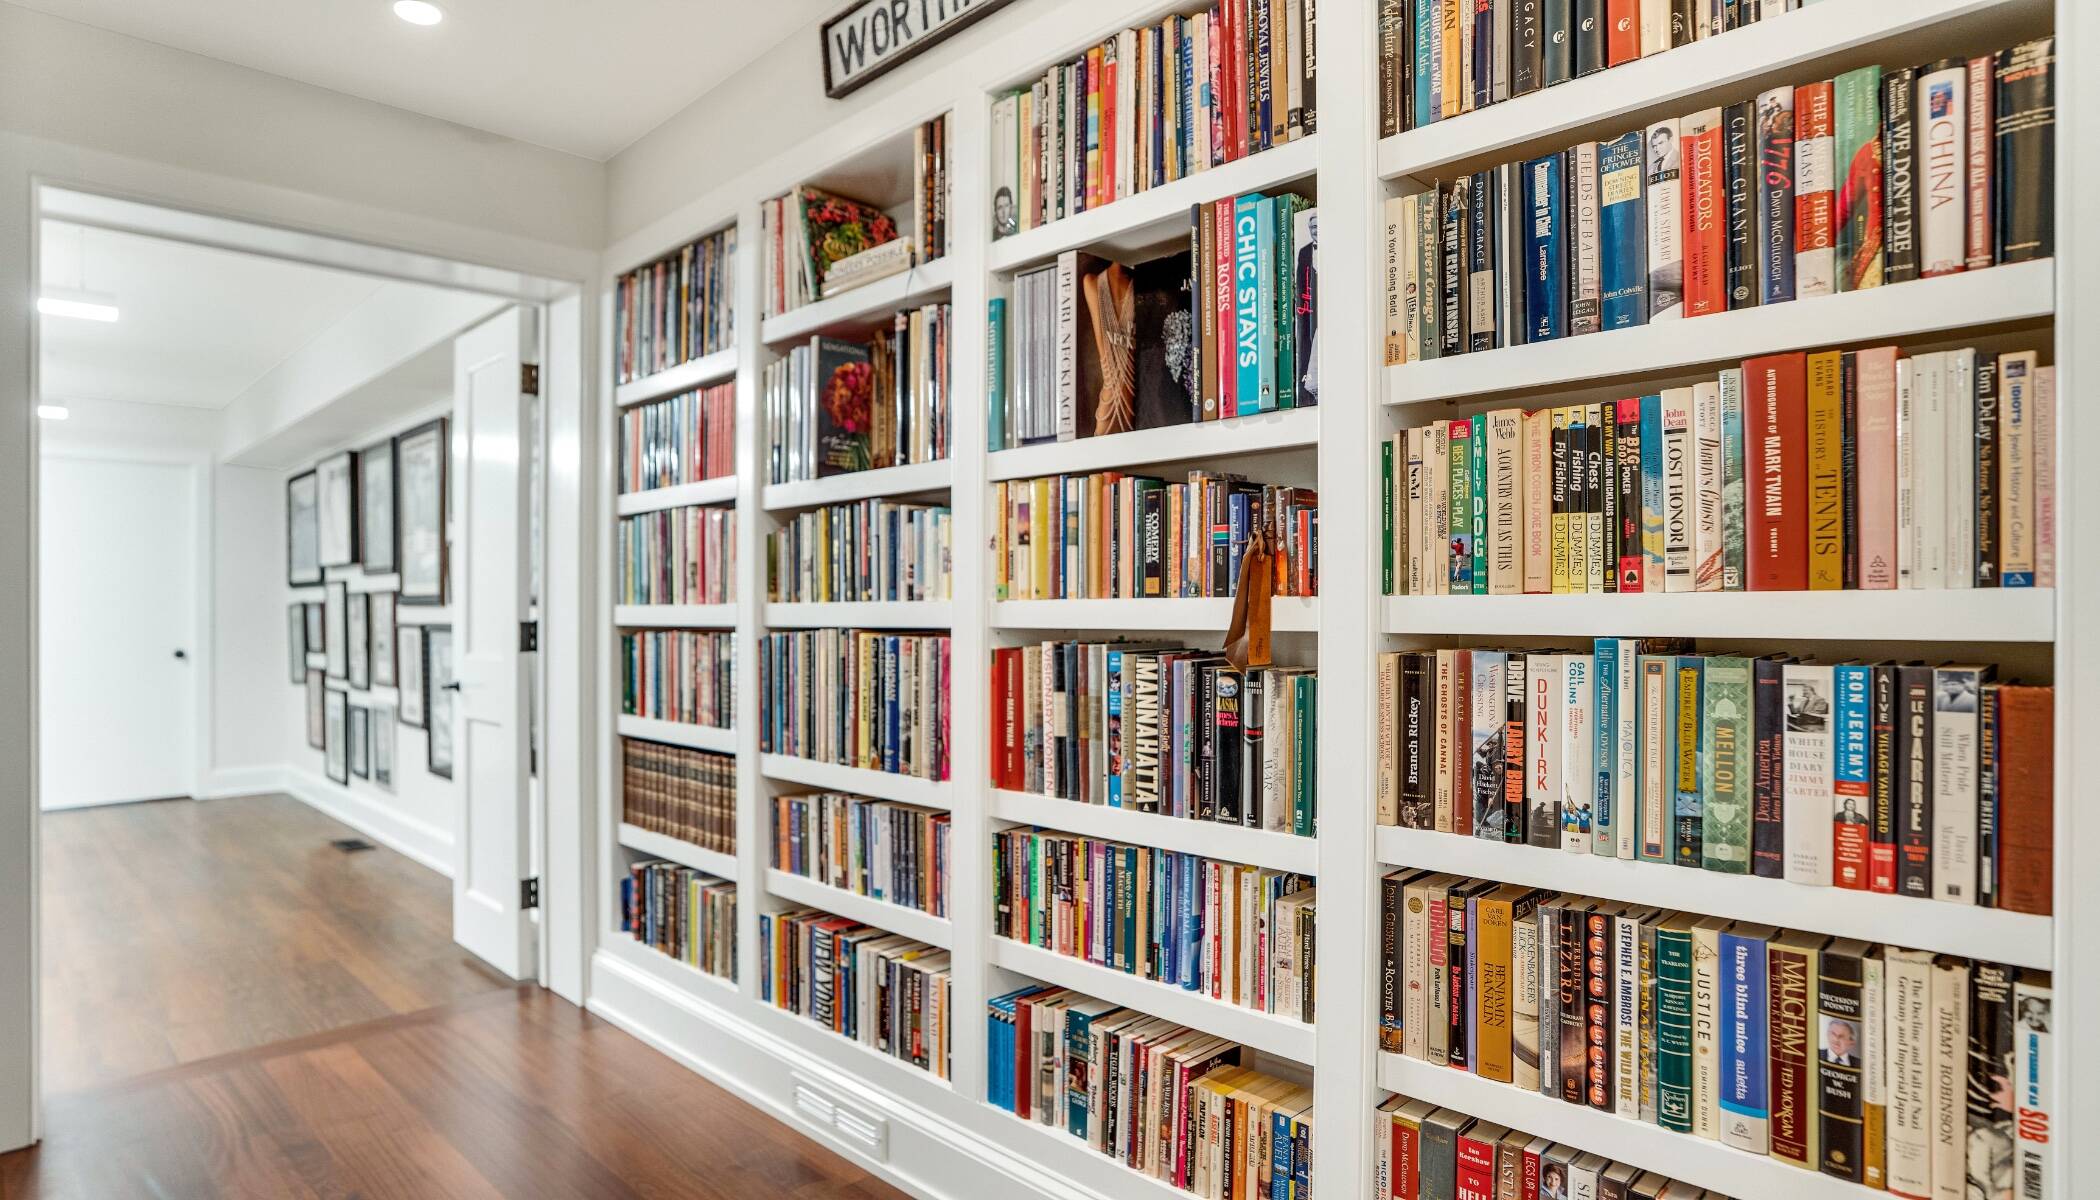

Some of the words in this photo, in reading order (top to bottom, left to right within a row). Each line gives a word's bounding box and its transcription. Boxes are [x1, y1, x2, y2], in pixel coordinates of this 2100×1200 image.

[1259, 53, 1270, 102] JEWELS
[1602, 149, 1640, 166] FRINGES
[1731, 116, 1747, 167] CARY
[1895, 120, 1912, 154] WE
[1580, 153, 1593, 202] FIELDS
[1761, 137, 1793, 189] 1776
[1929, 121, 1955, 211] CHINA
[1475, 181, 1484, 209] DAYS
[1697, 139, 1713, 233] DICTATORS
[1894, 155, 1912, 219] DON'T
[1475, 210, 1484, 227] OF
[1581, 205, 1593, 226] OF
[1731, 177, 1748, 245] GRANT
[1238, 215, 1256, 282] CHIC
[1475, 229, 1485, 265] GRACE
[1894, 219, 1912, 254] DIE
[1539, 245, 1548, 281] Larrabee
[1582, 230, 1595, 296] BATTLE
[1061, 271, 1072, 329] PEARL
[1217, 263, 1230, 313] ROSES
[1239, 286, 1258, 369] STAYS
[1060, 333, 1072, 428] NECKLACE
[1815, 359, 1823, 388] EVANS
[1825, 359, 1833, 396] RICHARD
[1977, 361, 1996, 394] Tom
[1663, 409, 1686, 419] John
[1767, 368, 1777, 423] AUTOBIOGRAPHY
[2010, 385, 2022, 425] IDIOT'S
[1663, 417, 1687, 426] Dean
[1767, 424, 1777, 434] OF
[1815, 410, 1825, 461] HISTORY
[1976, 397, 1996, 441] DeLay
[1453, 445, 1464, 467] BEST
[1553, 441, 1567, 458] Fly
[1617, 437, 1626, 466] BOOK
[1668, 438, 1683, 481] LOST
[1765, 436, 1781, 473] MARK
[1453, 468, 1464, 500] PLACES
[1552, 460, 1567, 503] Fishing
[1569, 449, 1584, 492] Fishing
[1588, 451, 1601, 491] Chess
[1622, 466, 1631, 495] POKER
[1669, 483, 1684, 543] HONOR
[1766, 474, 1782, 516] TWAIN
[1815, 469, 1838, 556] TENNIS
[1453, 506, 1464, 528] PLAY
[1473, 496, 1484, 558] DOG
[1150, 512, 1159, 564] COMEDY
[1554, 522, 1566, 577] DUMMIES
[1571, 522, 1583, 577] DUMMIES
[1589, 522, 1601, 577] DUMMIES
[1045, 647, 1054, 730] VISIONARY
[1203, 673, 1212, 701] JOSEPH
[1440, 662, 1448, 681] THE
[1507, 660, 1525, 704] DRIVE
[1568, 662, 1577, 705] COLLINS
[1577, 662, 1586, 686] GAIL
[1849, 671, 1864, 704] RON
[1440, 683, 1448, 721] GHOSTS
[1475, 673, 1487, 717] CROSSING
[1488, 664, 1500, 729] WASHINGTON'S
[1136, 662, 1159, 804] MANNAHATTA
[1408, 696, 1421, 738] Rickey
[1440, 723, 1448, 735] OF
[1536, 678, 1549, 791] DUNKIRK
[1045, 732, 1054, 791] WOMEN
[1409, 738, 1419, 785] Branch
[1439, 737, 1448, 776] CANNAE
[1506, 720, 1524, 768] LARRY
[1623, 720, 1633, 779] MAJOLICA
[1714, 726, 1735, 793] MELLON
[1788, 737, 1826, 748] WHITE
[1788, 751, 1826, 761] HOUSE
[1848, 710, 1864, 778] JEREMY
[1878, 733, 1889, 774] VILLAGE
[1263, 758, 1273, 792] WAR
[1756, 739, 1770, 789] America
[1788, 773, 1825, 786] JIMMY
[1789, 762, 1823, 773] DIARY
[1506, 769, 1524, 803] BIRD
[1755, 790, 1770, 822] Dear
[1786, 785, 1829, 798] CARTER
[1877, 774, 1889, 834] VANGUARD
[1385, 882, 1396, 911] JOHN
[1303, 933, 1312, 950] Hard
[1385, 913, 1396, 955] GRISHAM
[1517, 926, 1527, 952] LUCK
[1594, 919, 1603, 942] JOHN
[1620, 923, 1632, 967] STEPHEN
[1303, 950, 1311, 970] Times
[1526, 927, 1537, 1005] RICKENBACKER'S
[1560, 924, 1573, 1004] LIZARD
[1573, 941, 1581, 991] TERRIBLE
[1594, 945, 1603, 997] FEINSTEIN
[1620, 968, 1631, 979] E.
[1735, 944, 1749, 981] three
[815, 978, 833, 1027] YORK
[1483, 961, 1495, 1027] FRANKLIN
[1494, 964, 1505, 1029] BENJAMIN
[1620, 979, 1632, 1028] AMBROSE
[1697, 968, 1711, 1041] JUSTICE
[1735, 983, 1749, 1020] blind
[1771, 974, 1782, 1051] BIOGRAPHY
[1781, 960, 1806, 1058] MAUGHAM
[1819, 991, 1860, 1008] DECISION
[1823, 1000, 1855, 1014] POINTS
[1894, 975, 1909, 1023] Germany
[1595, 1008, 1603, 1026] THE
[1735, 1020, 1749, 1054] mice
[1897, 1024, 1908, 1046] and
[1939, 1007, 1953, 1059] JIMMY
[1595, 1027, 1603, 1050] LAST
[1620, 1028, 1632, 1049] THE
[1110, 1051, 1119, 1079] TIGER
[1595, 1052, 1604, 1103] AMATEURS
[1621, 1050, 1632, 1076] WILD
[1735, 1059, 1749, 1100] auletta
[1782, 1067, 1794, 1088] TED
[1820, 1067, 1858, 1084] GEORGE
[1893, 1048, 1907, 1096] Imperial
[1621, 1076, 1632, 1101] BLUE
[1825, 1086, 1852, 1100] BUSH
[1939, 1064, 1953, 1147] ROBINSON
[1198, 1100, 1206, 1141] PAPILLON
[1774, 1088, 1795, 1139] MORGAN
[1893, 1096, 1908, 1128] Japan
[1274, 1131, 1283, 1161] AUEL
[1459, 1151, 1491, 1167] Kershaw
[1468, 1146, 1481, 1156] Ian
[1503, 1149, 1514, 1189] LAST
